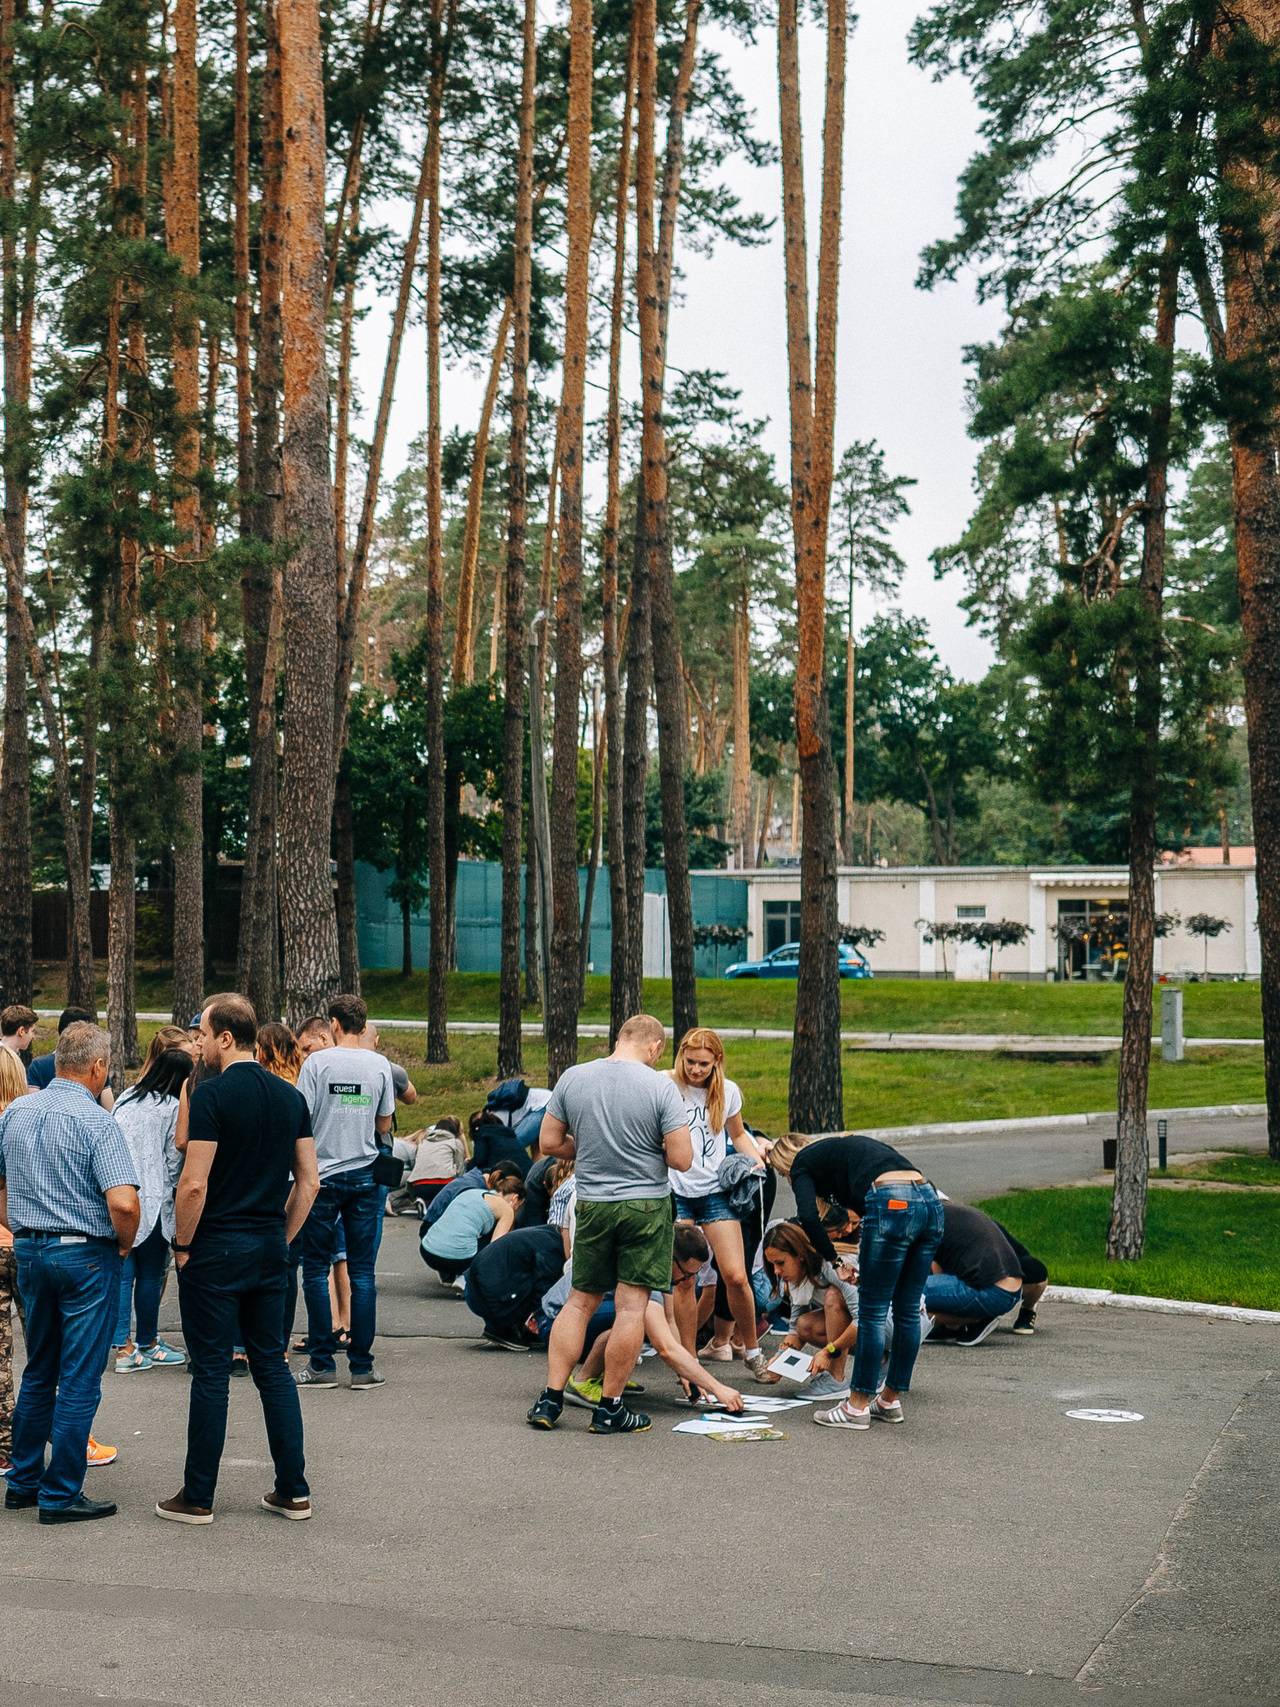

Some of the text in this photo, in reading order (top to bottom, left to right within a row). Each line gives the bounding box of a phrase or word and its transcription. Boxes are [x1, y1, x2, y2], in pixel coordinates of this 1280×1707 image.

[333, 1085, 356, 1093] quest
[342, 1096, 371, 1105] agency
[154, 1351, 167, 1360] N
[135, 1356, 143, 1365] N
[298, 1370, 311, 1382] N
